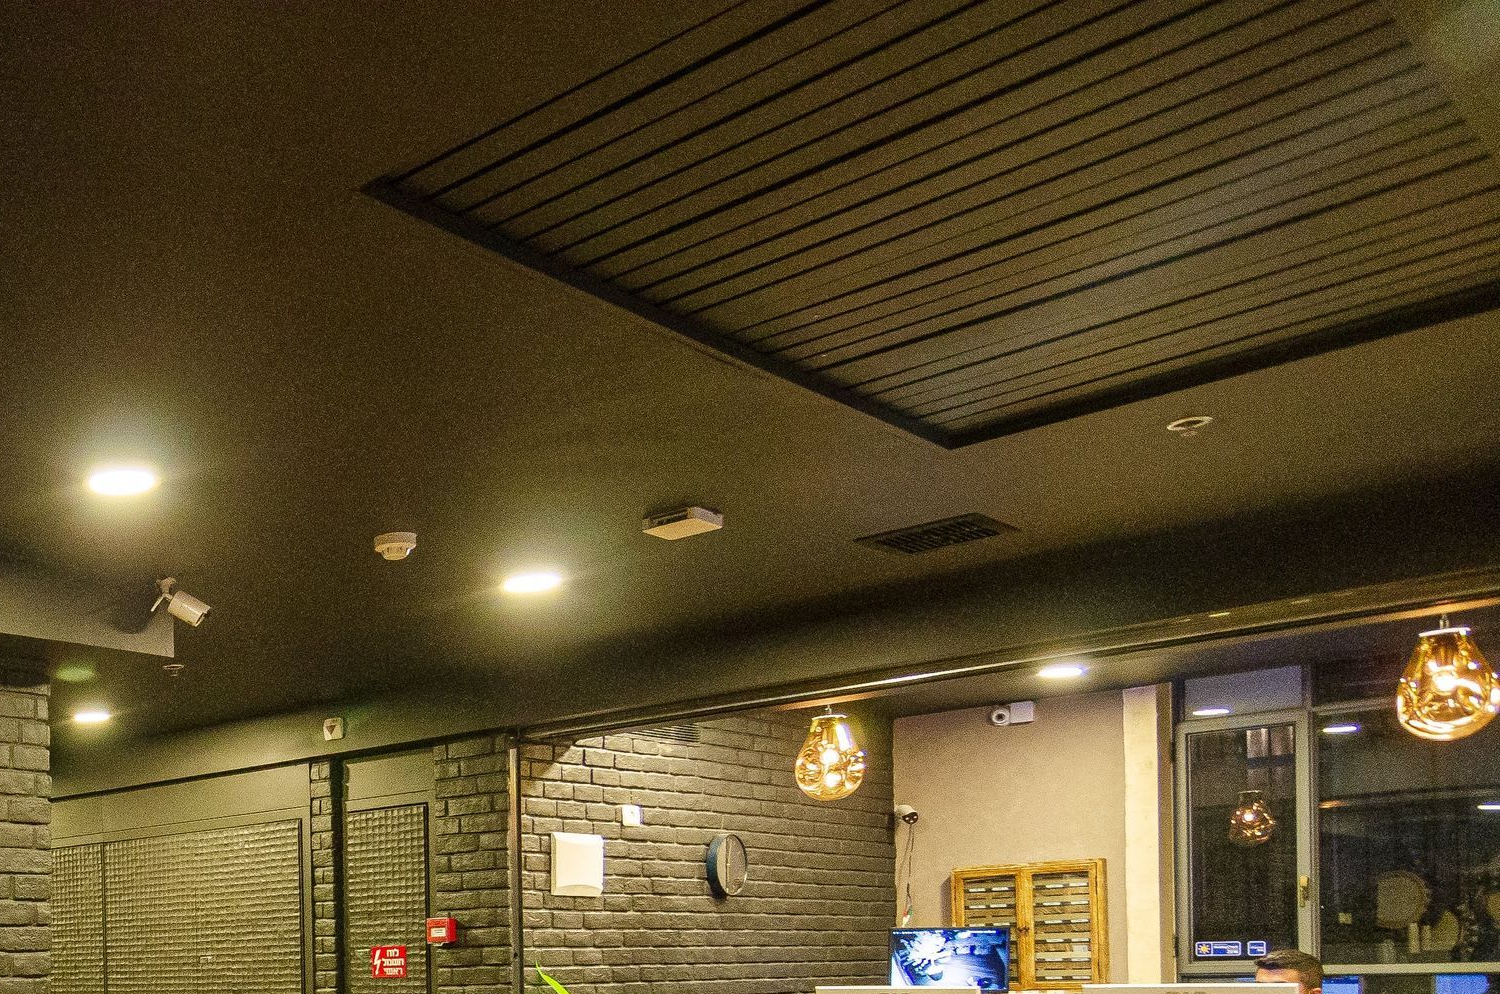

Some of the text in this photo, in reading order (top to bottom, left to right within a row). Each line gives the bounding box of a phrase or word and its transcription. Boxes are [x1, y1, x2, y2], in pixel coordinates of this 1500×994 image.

[386, 948, 400, 957] לוח
[381, 958, 404, 967] חשמל
[382, 967, 403, 975] ראשי
